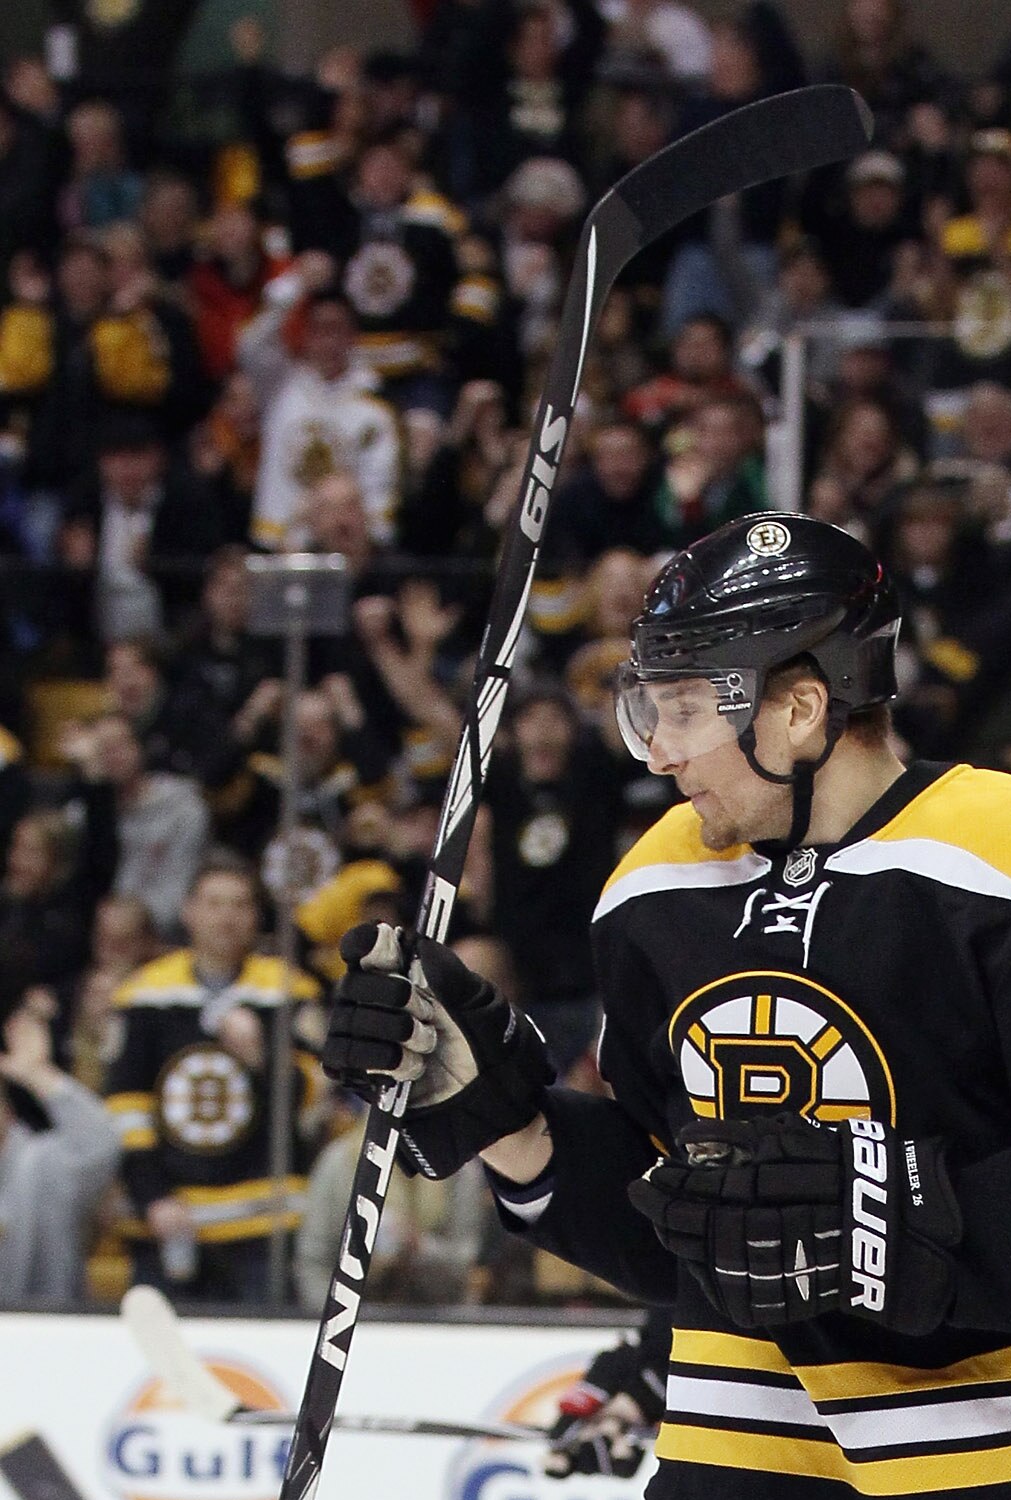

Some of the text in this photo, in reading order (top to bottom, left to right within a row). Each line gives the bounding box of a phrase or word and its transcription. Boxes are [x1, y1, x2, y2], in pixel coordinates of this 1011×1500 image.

[520, 404, 567, 543] S19
[848, 1118, 888, 1312] BAUER
[906, 1146, 923, 1192] WHEELER
[912, 1193, 924, 1207] 26
